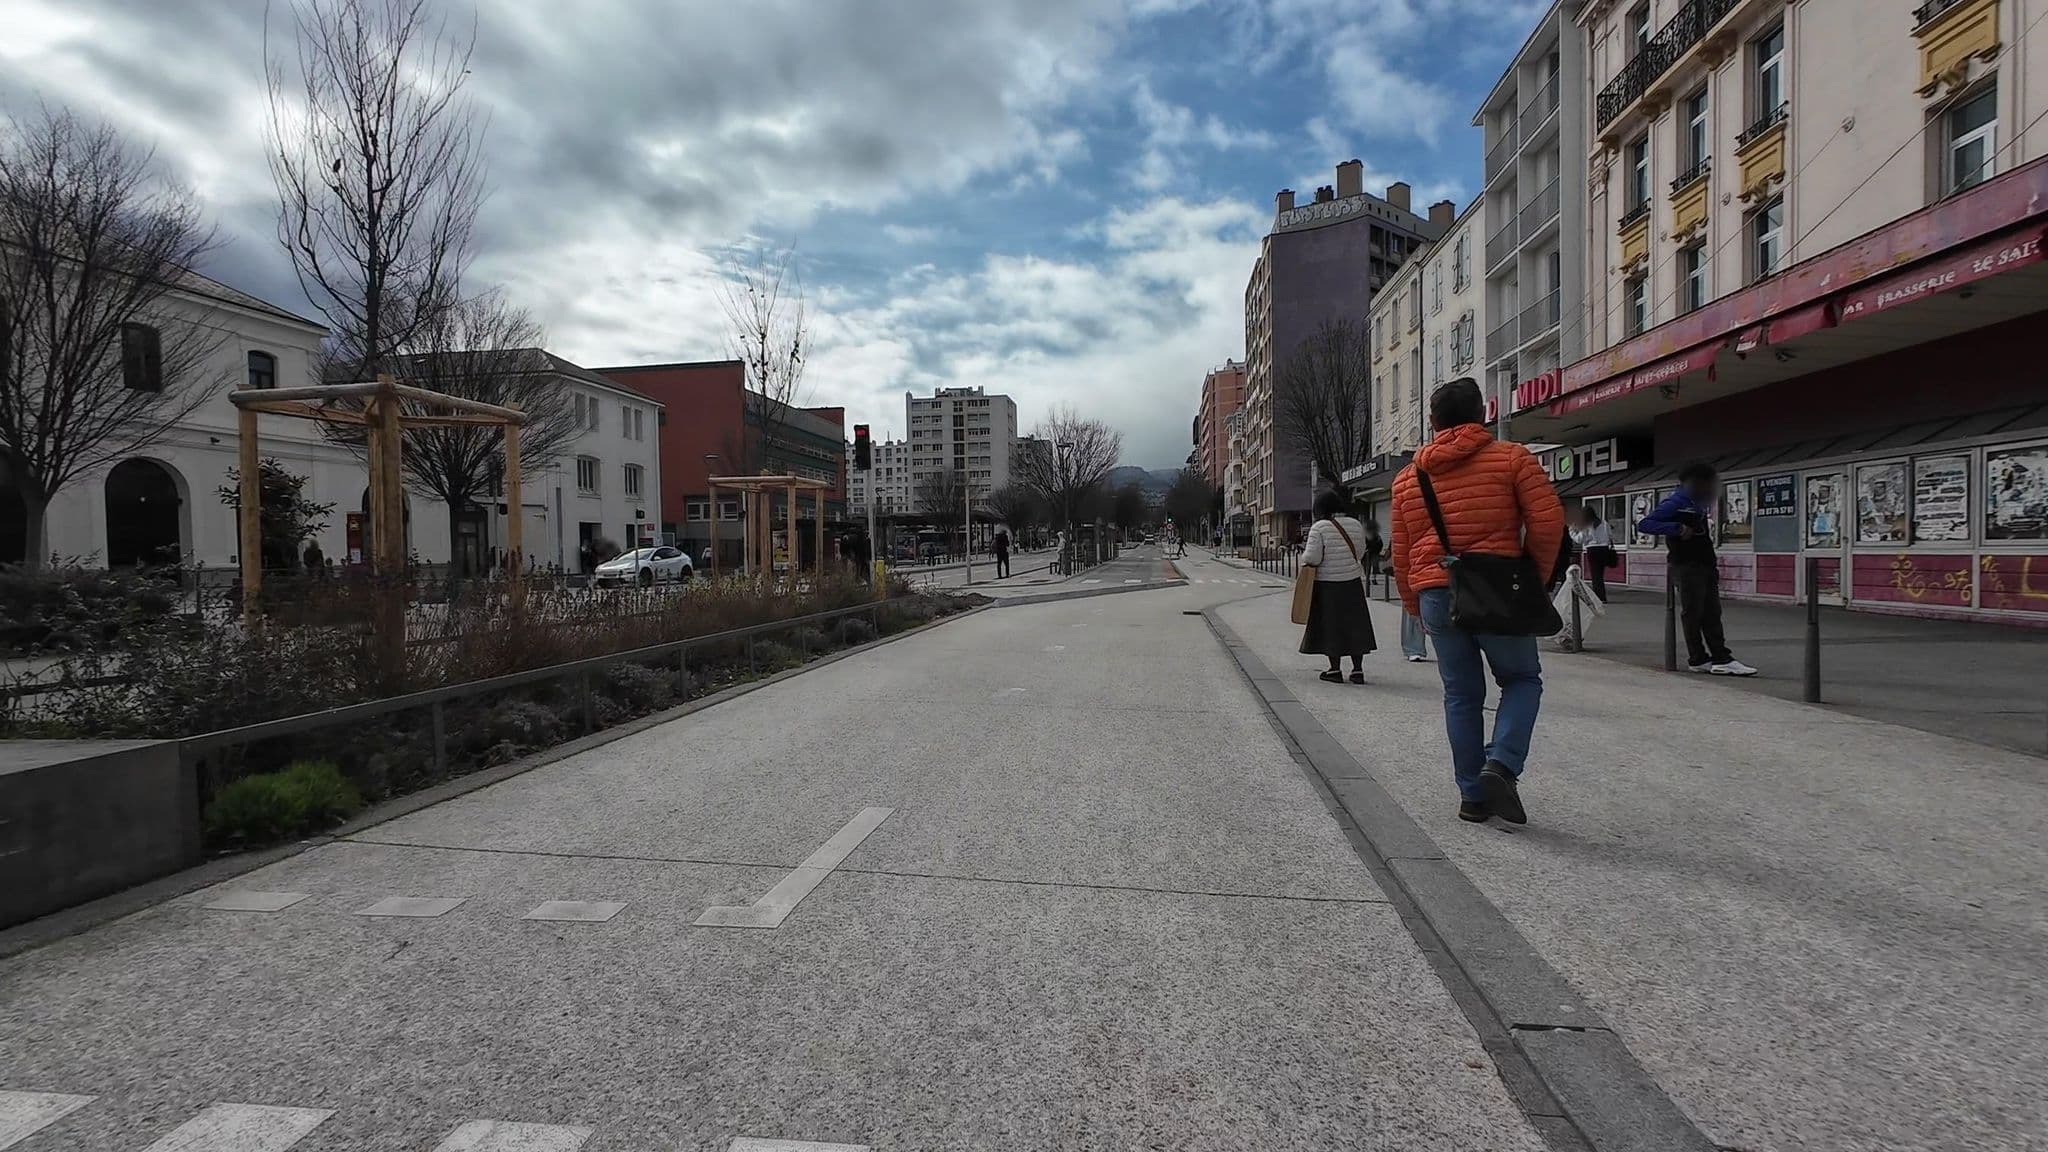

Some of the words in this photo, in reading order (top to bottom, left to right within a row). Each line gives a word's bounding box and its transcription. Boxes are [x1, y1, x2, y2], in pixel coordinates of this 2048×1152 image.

[1877, 272, 1956, 309] BRASSERIE
[1516, 368, 1562, 410] MIDI
[1766, 476, 1792, 487] VENDRE
